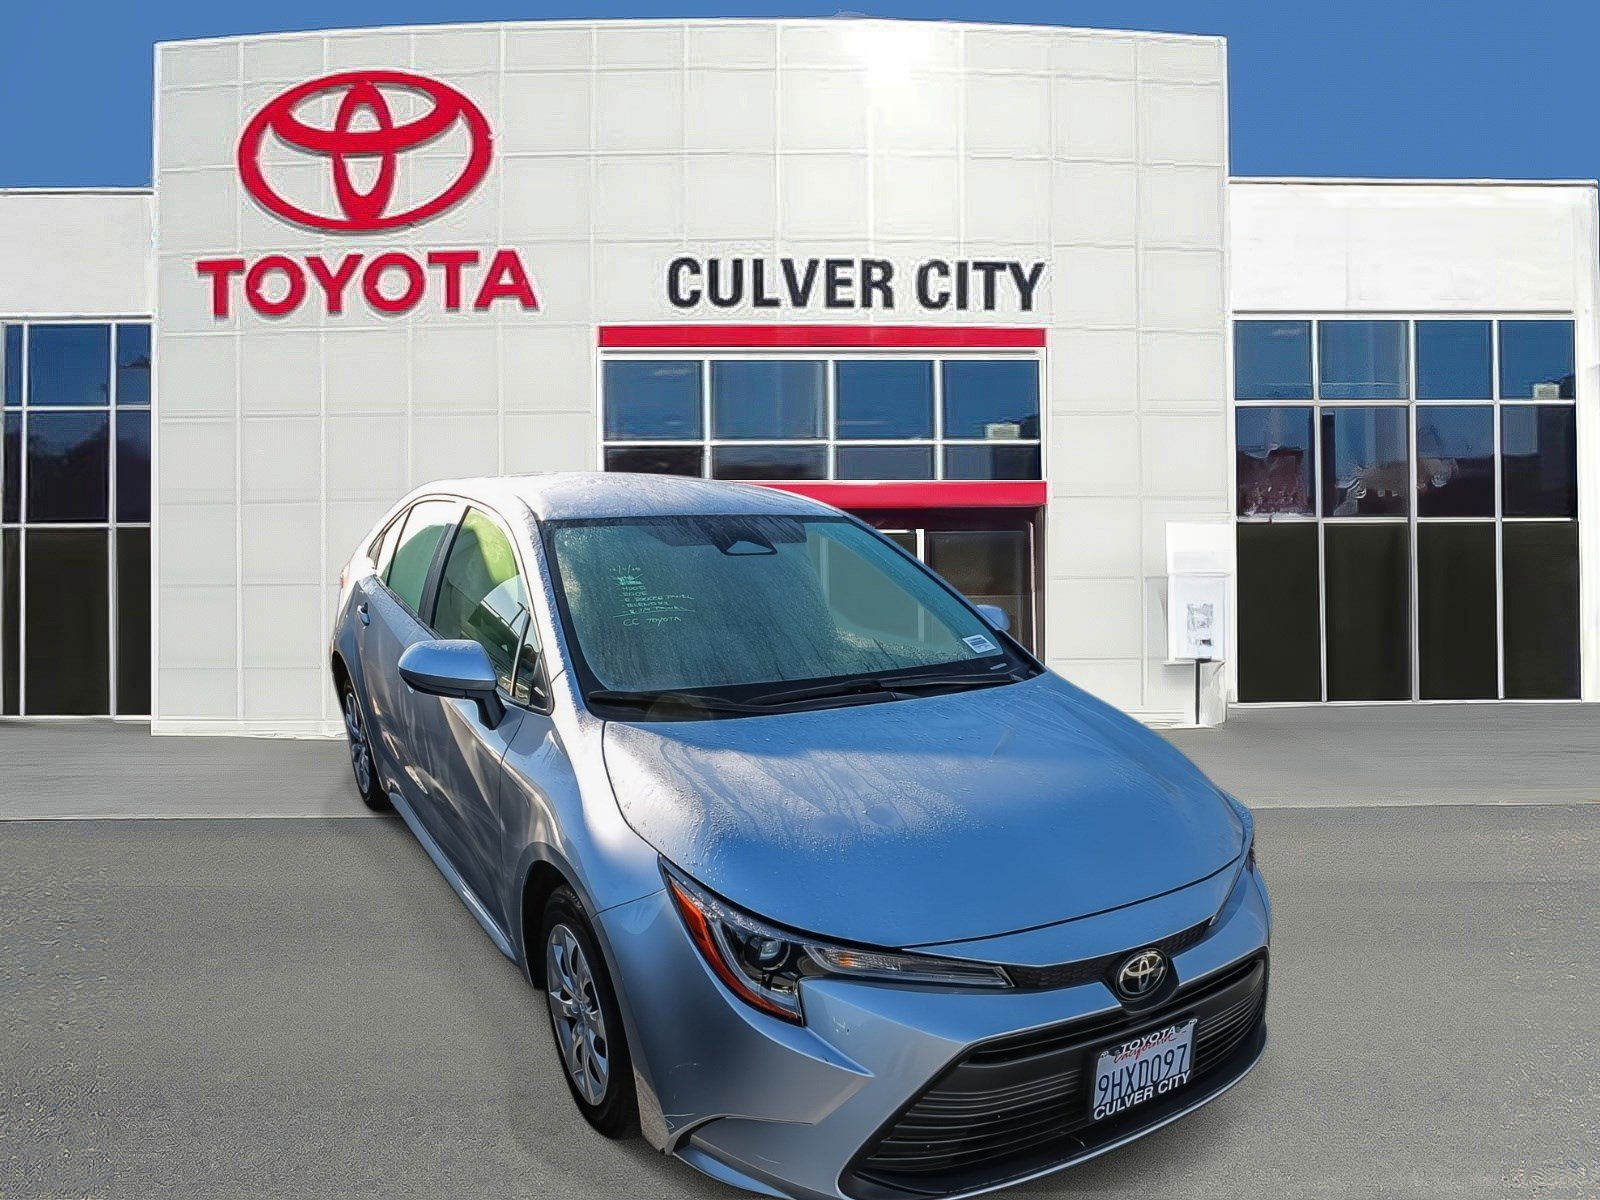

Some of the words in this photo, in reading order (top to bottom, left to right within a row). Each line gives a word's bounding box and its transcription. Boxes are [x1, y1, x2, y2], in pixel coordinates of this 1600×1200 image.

[195, 249, 539, 318] TOYOTA
[667, 256, 896, 309] CULVER
[915, 258, 1046, 311] CITY
[1121, 1026, 1177, 1054] TOYOTA
[1093, 1086, 1154, 1121] CULVER
[1157, 1070, 1191, 1094] CITY
[1098, 1043, 1188, 1105] 9HXD097
